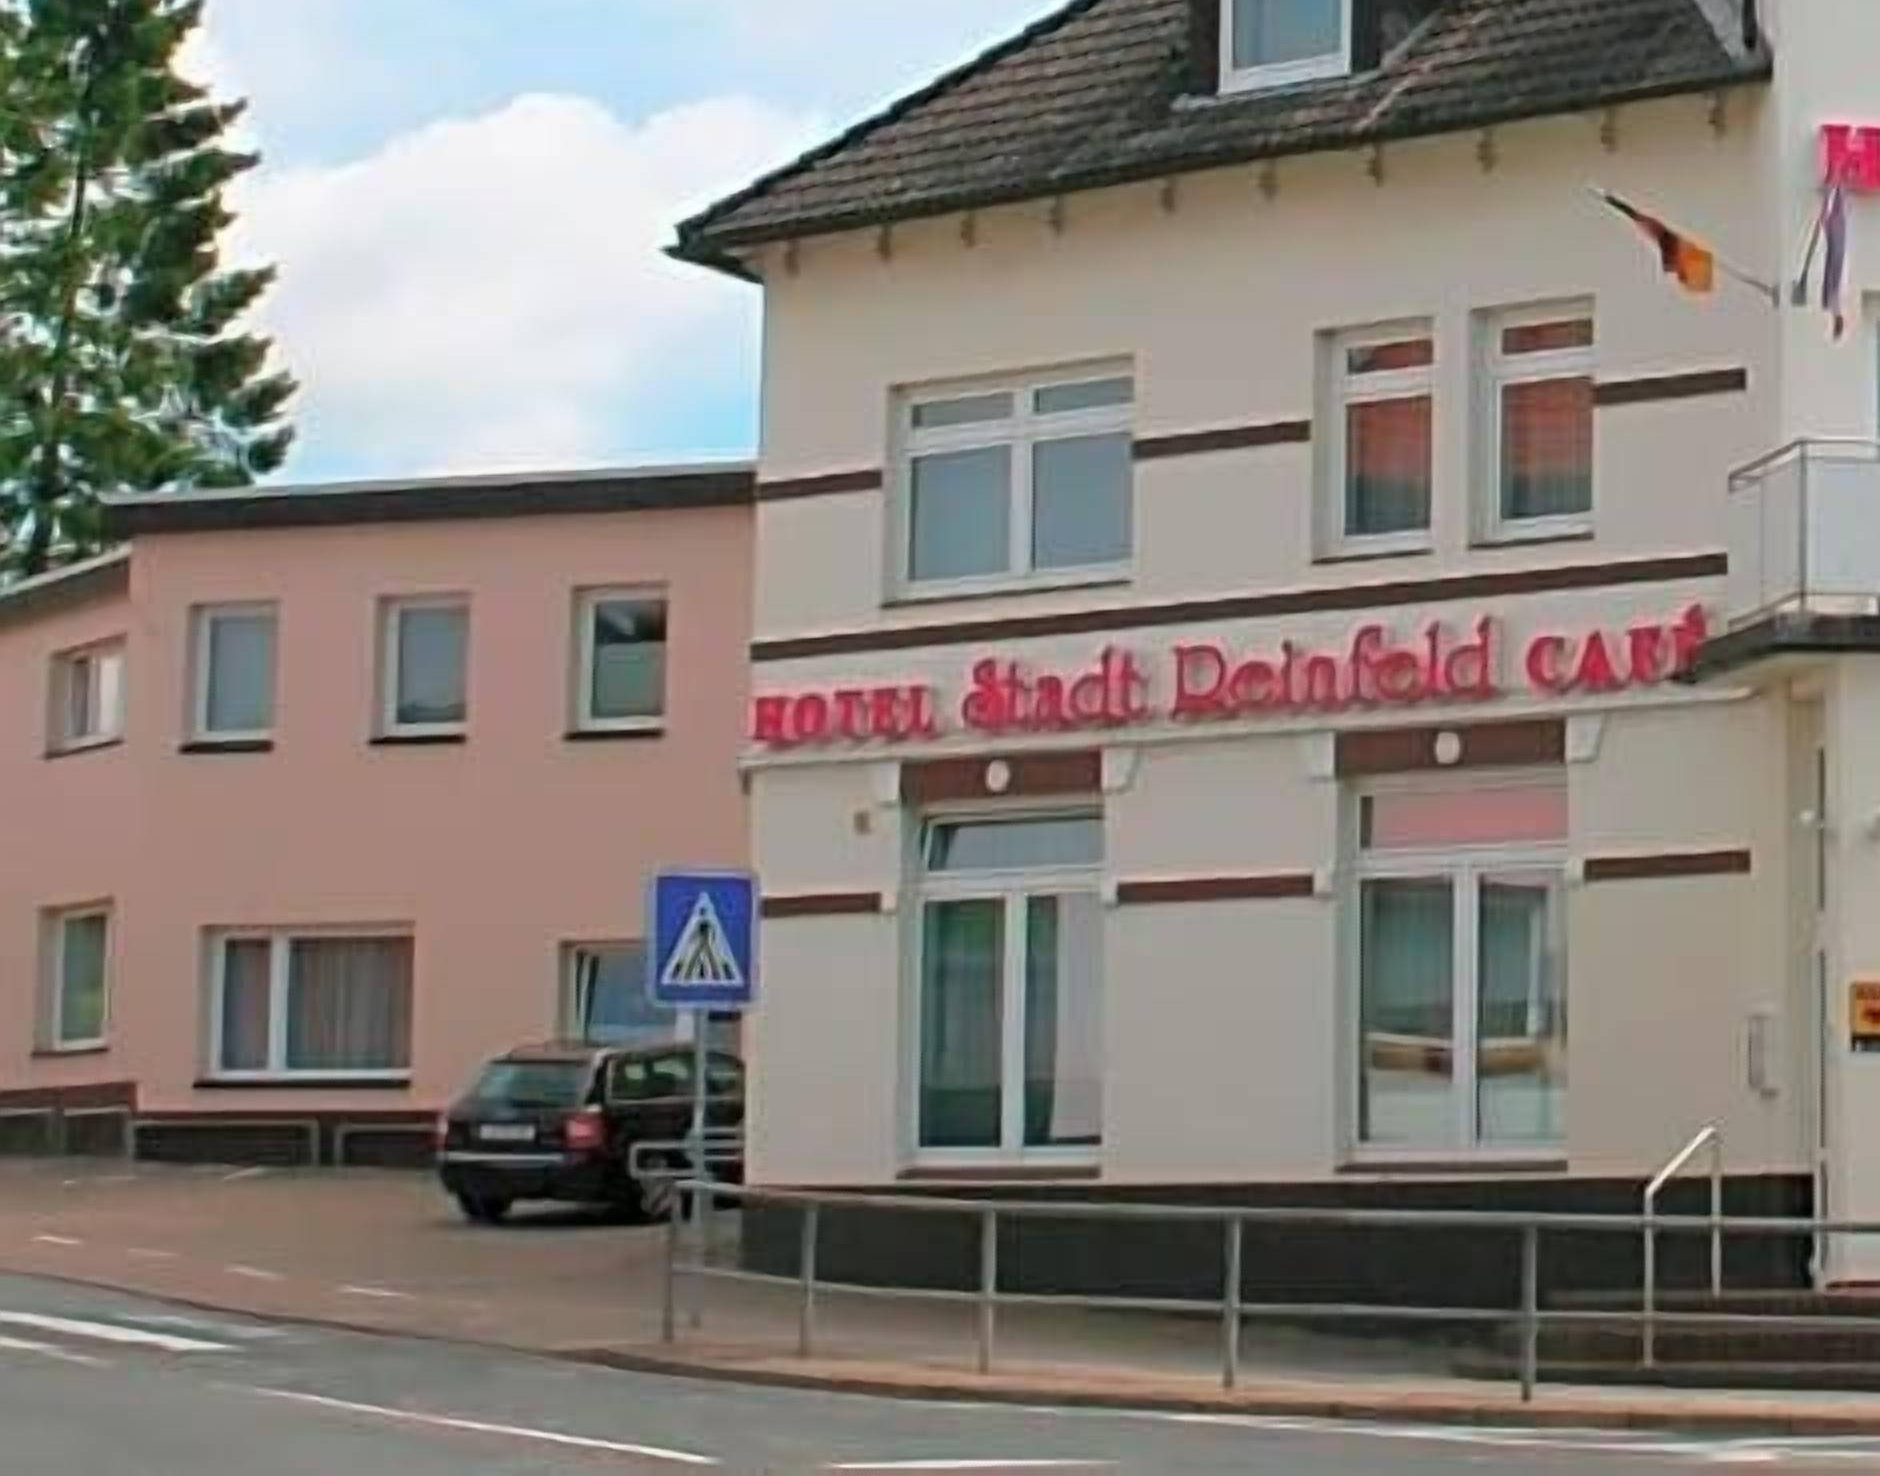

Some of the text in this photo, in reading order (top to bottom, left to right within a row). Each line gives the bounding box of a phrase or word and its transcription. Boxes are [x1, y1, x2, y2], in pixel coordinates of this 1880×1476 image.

[755, 684, 937, 746] HOTEL
[961, 646, 1150, 736] Stadt
[1170, 614, 1499, 722] Reinfeld
